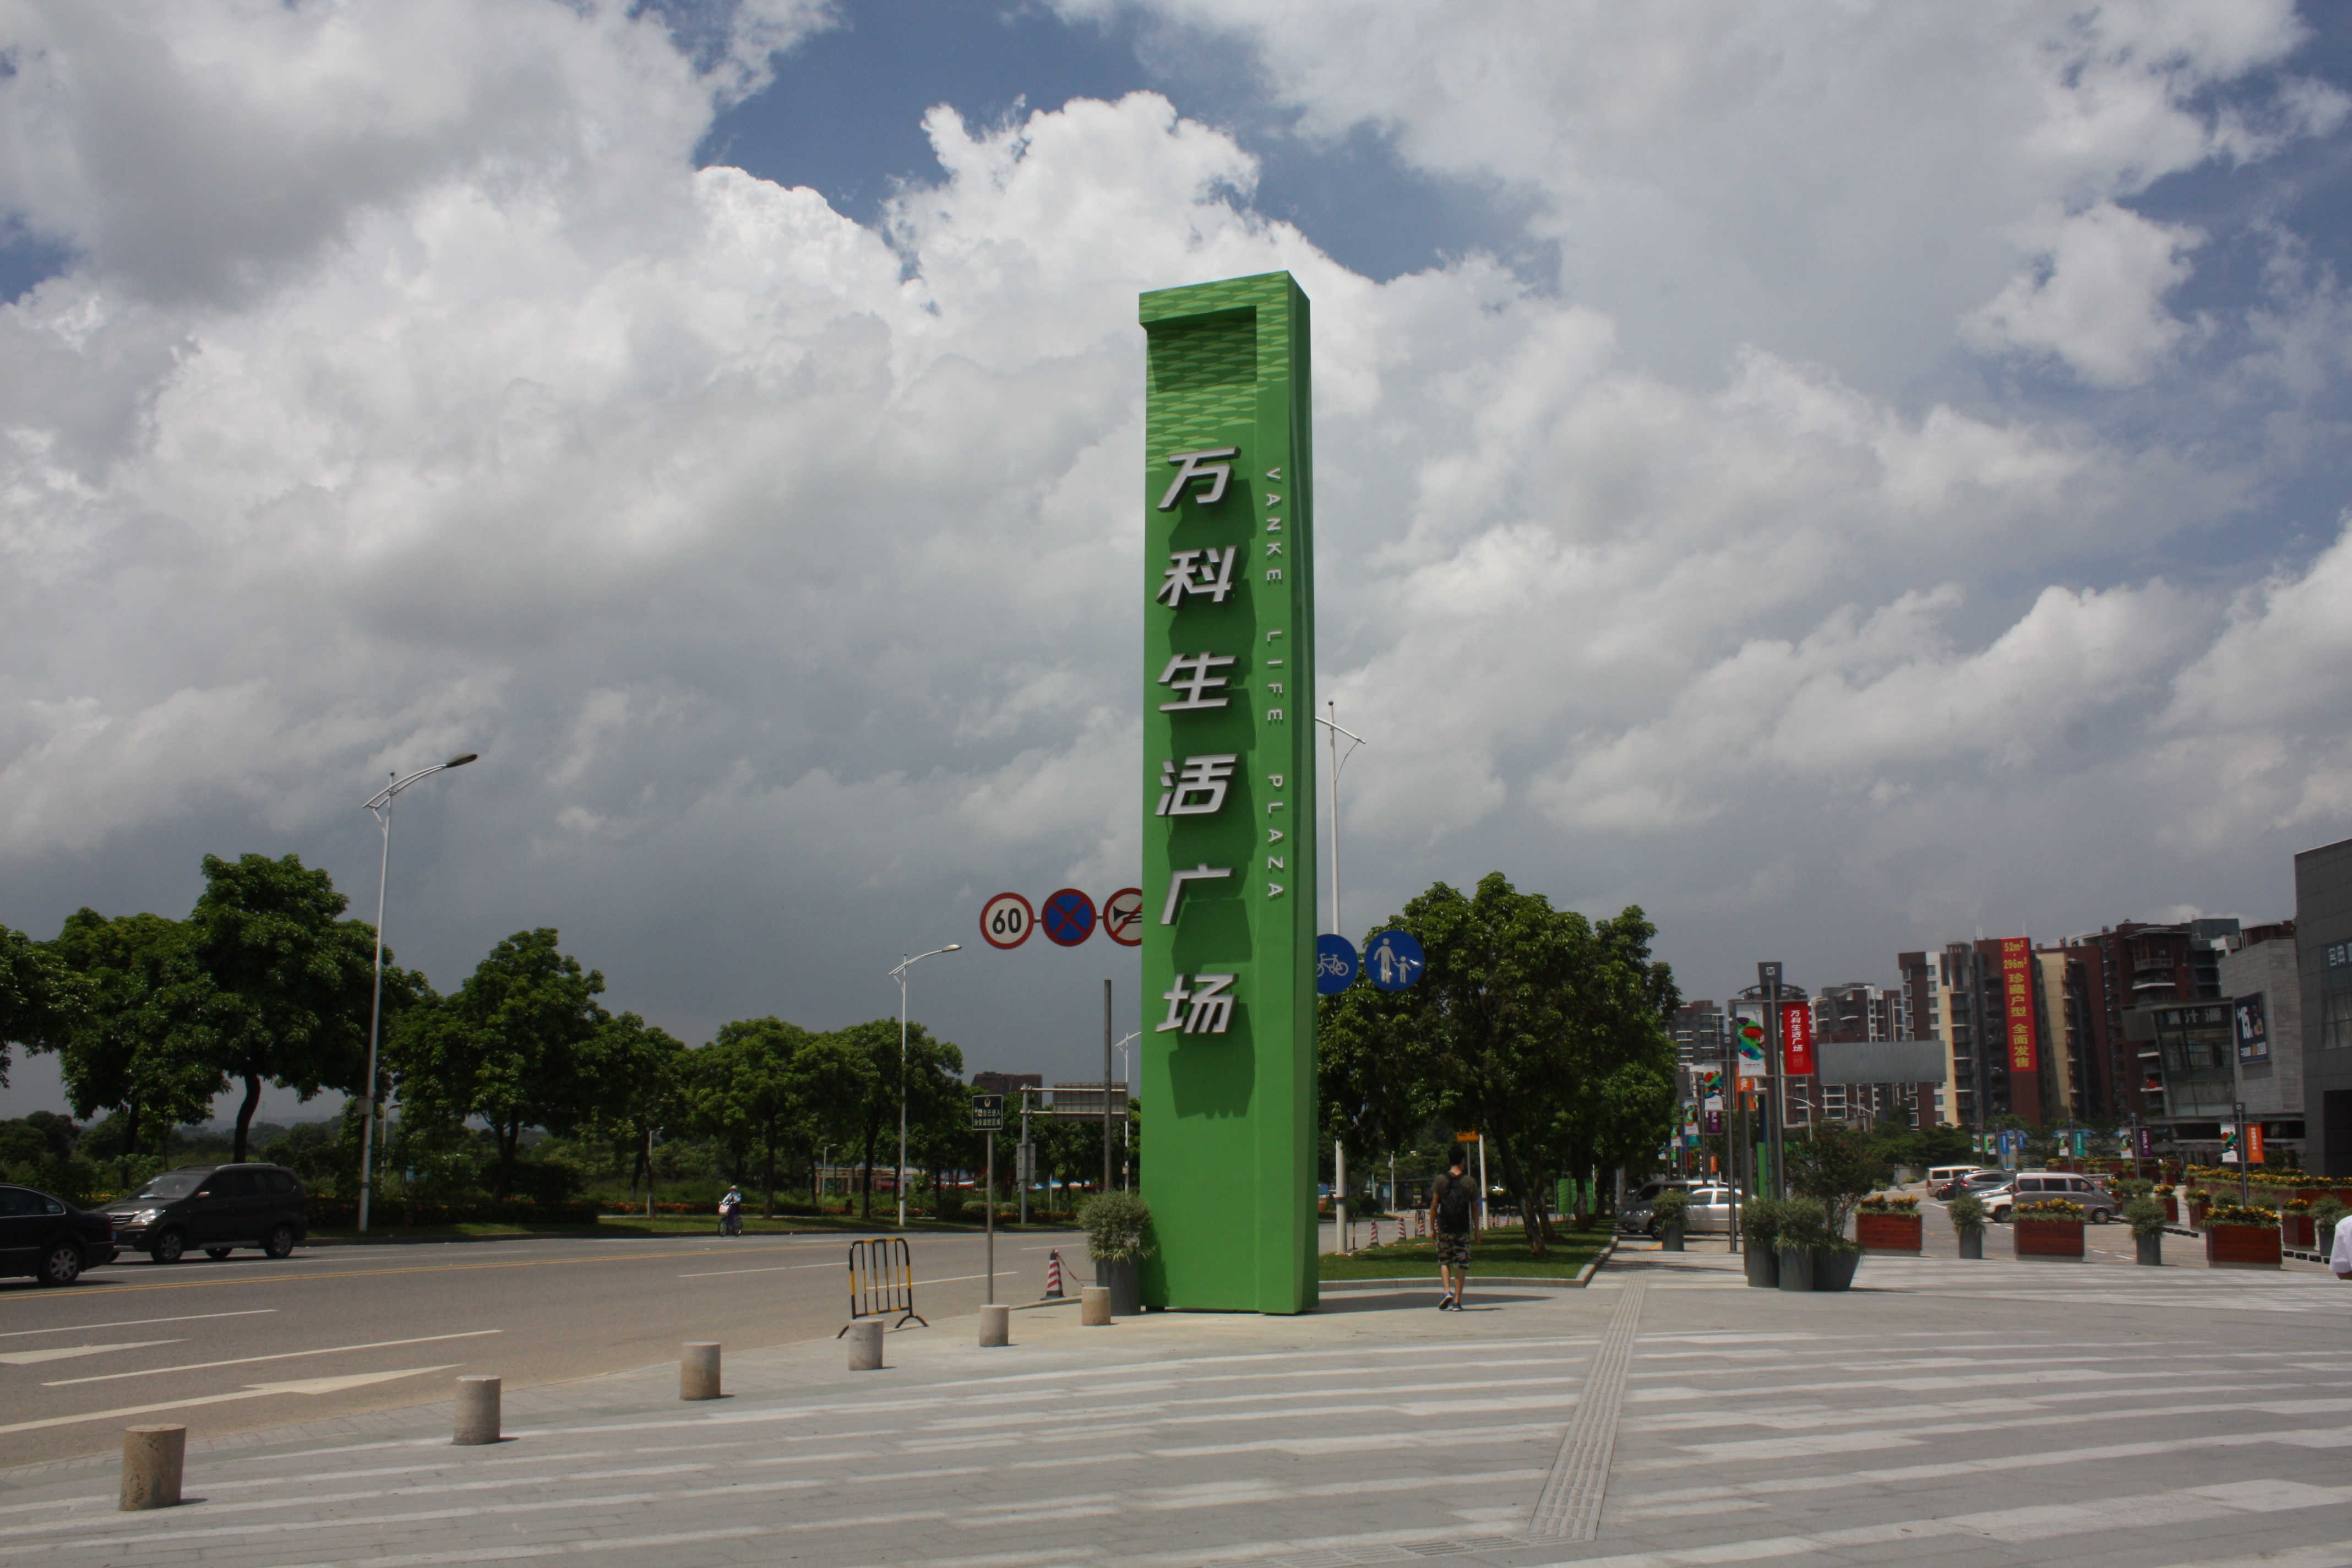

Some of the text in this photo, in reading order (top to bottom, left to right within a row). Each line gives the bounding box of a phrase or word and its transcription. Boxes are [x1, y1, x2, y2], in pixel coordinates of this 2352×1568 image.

[1266, 466, 1284, 899] VANKE LIFE PLAZA
[1156, 447, 1241, 1034] 万科生活广场
[992, 908, 1022, 934] 60
[1790, 1009, 1803, 1052] 万科生活广场
[2012, 1023, 2030, 1068] 全面发售
